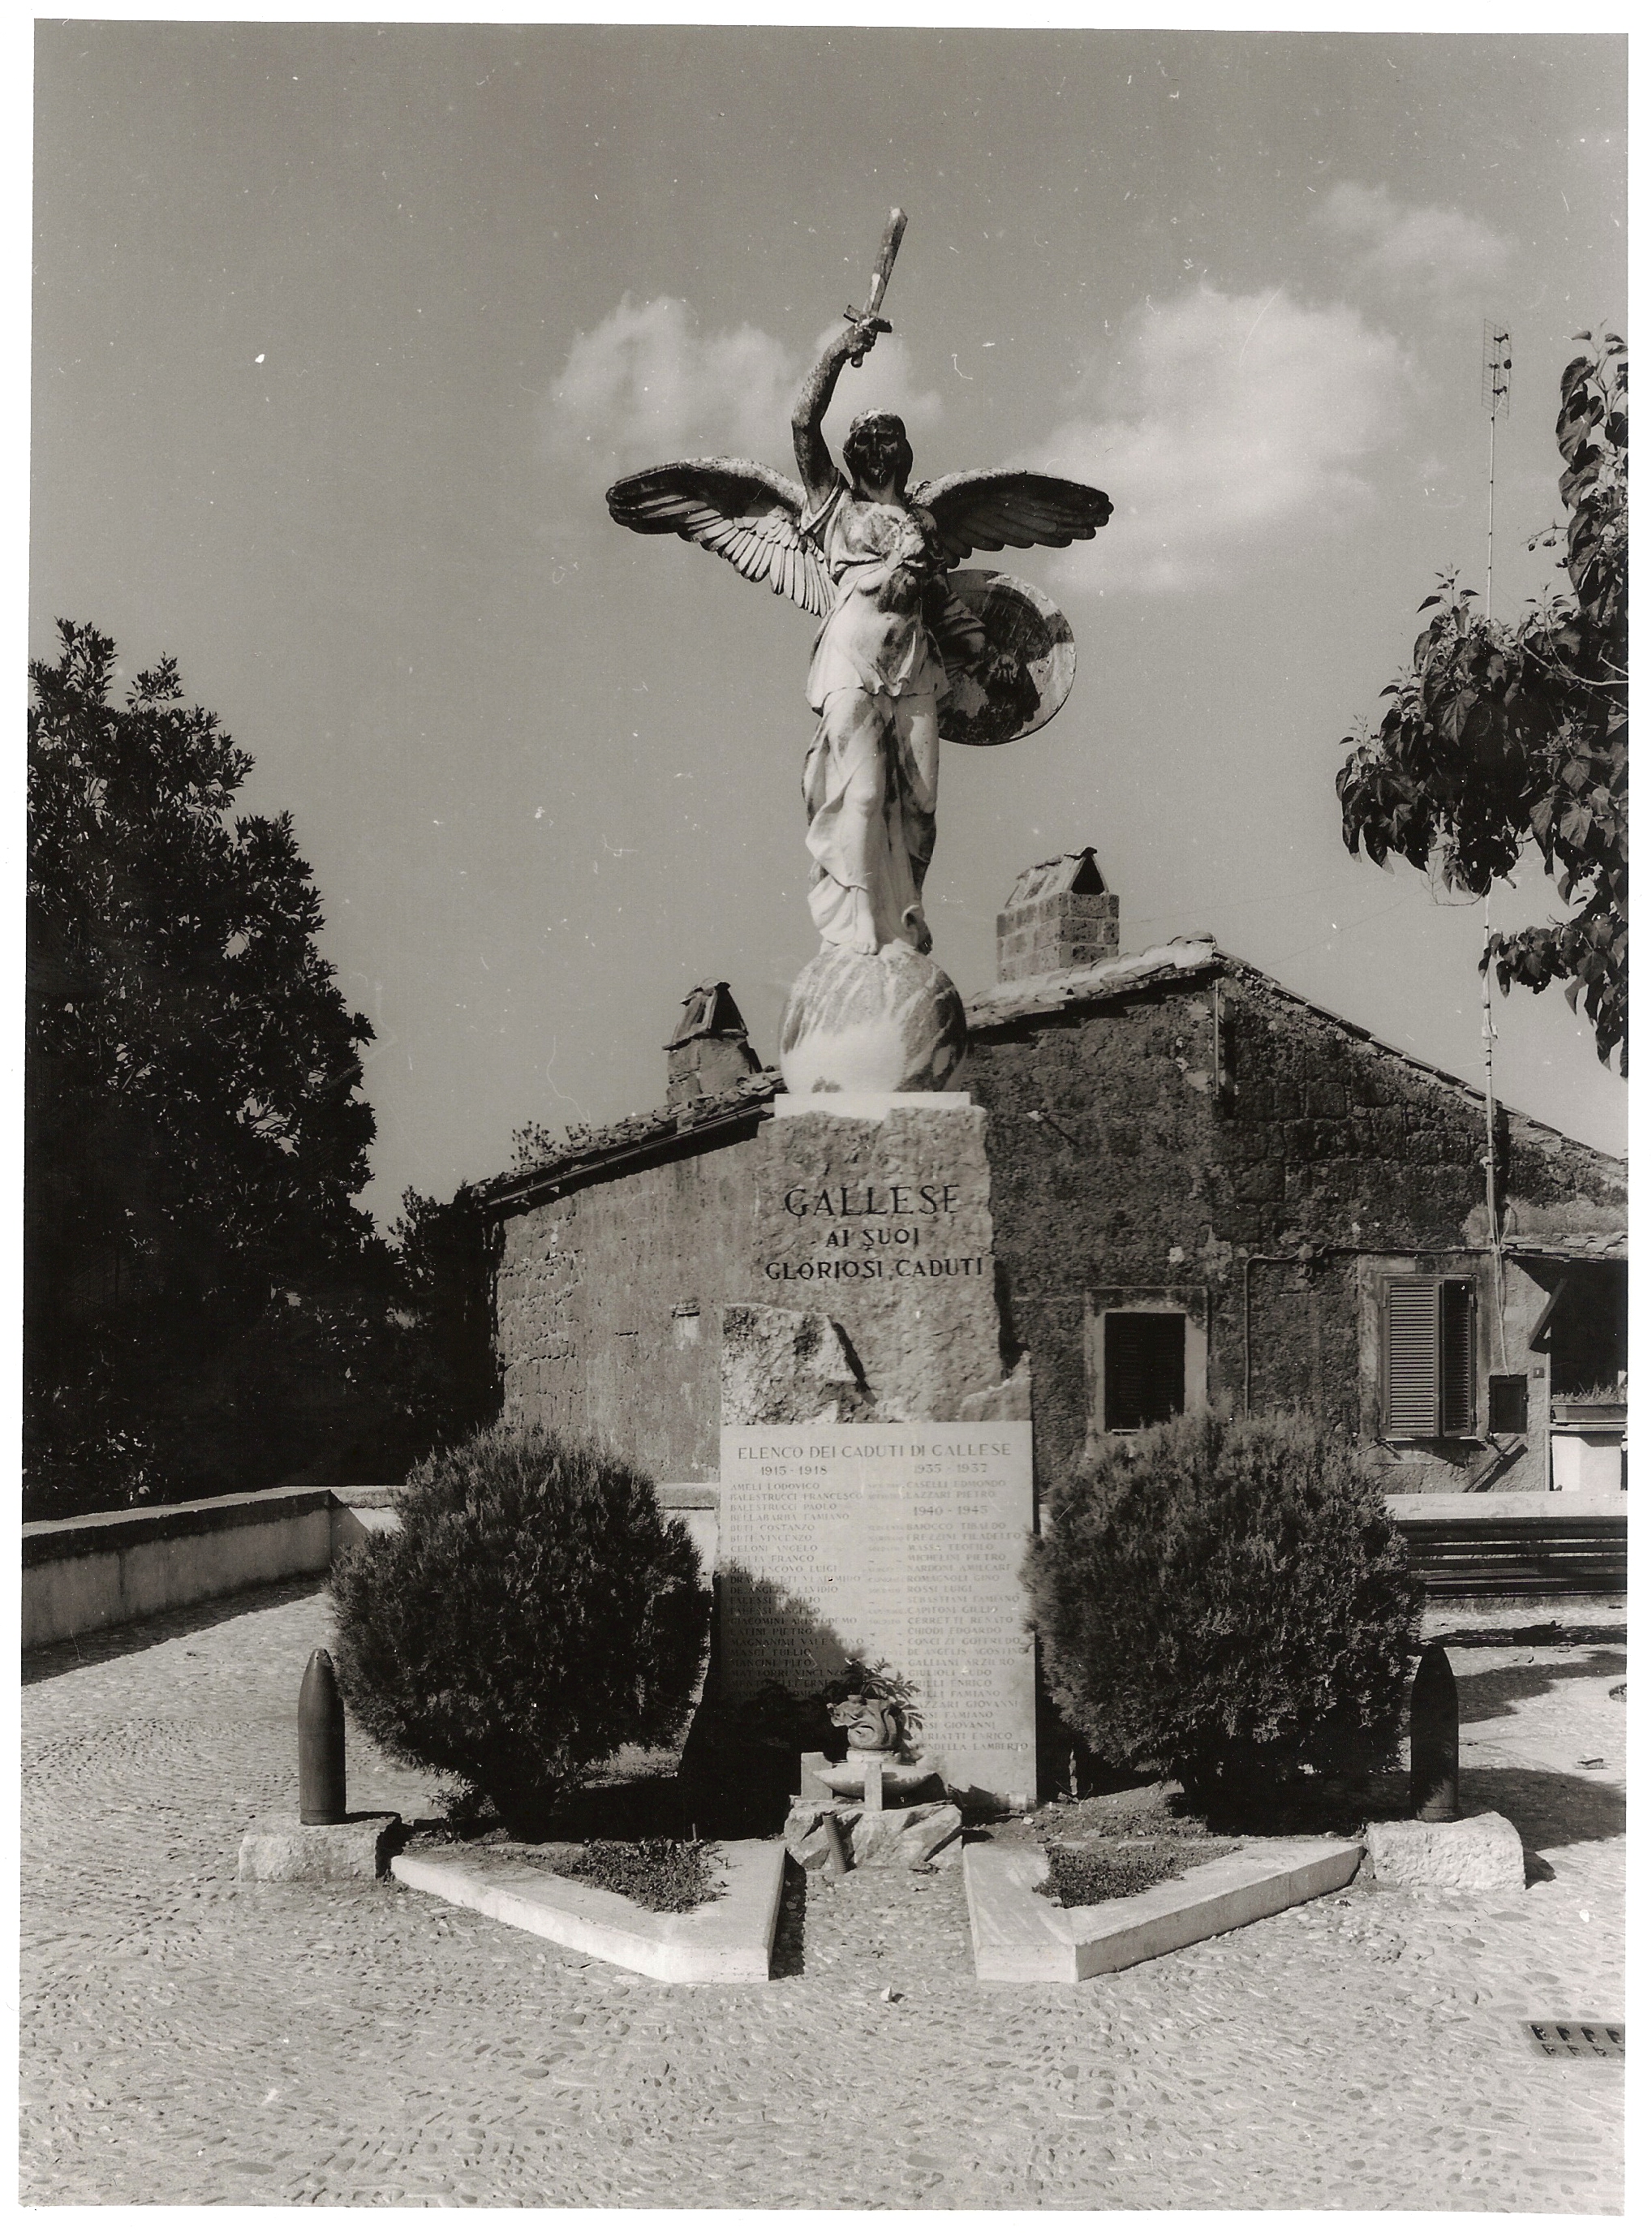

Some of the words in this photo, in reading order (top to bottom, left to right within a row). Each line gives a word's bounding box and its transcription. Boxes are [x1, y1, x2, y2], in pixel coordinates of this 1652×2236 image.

[785, 1185, 961, 1218] GALLESE
[824, 1228, 850, 1248] AI
[862, 1228, 920, 1247] SUOI
[765, 1260, 883, 1281] GLORIOSI
[896, 1257, 983, 1278] CADUTI
[738, 1446, 804, 1460] ELENCO
[809, 1446, 836, 1459] DEI
[841, 1445, 904, 1459] CADUTI
[910, 1444, 926, 1457] DI
[931, 1443, 1012, 1457] GALLESE
[760, 1465, 787, 1476] 1915
[798, 1465, 828, 1476] 1918
[914, 1464, 942, 1474] 1935
[731, 1483, 762, 1491] AMELI
[768, 1482, 820, 1490] LODOVICO
[953, 1479, 1007, 1487] EDMONDO
[730, 1493, 798, 1502] BALESTRUCCI
[803, 1492, 863, 1500] FRANCESCO
[906, 1491, 951, 1499] LAZZARI
[956, 1490, 996, 1499] PIETRO
[730, 1503, 798, 1511] BALESTRUCCI
[803, 1503, 837, 1511] PAOLO
[914, 1506, 944, 1516] 1940
[957, 1505, 989, 1516] 1945
[730, 1514, 797, 1522] BELLABARBA
[803, 1513, 850, 1521] FAMIANO
[759, 1524, 815, 1532] COSTANZO
[730, 1545, 768, 1553] CELONI
[777, 1544, 818, 1552] ANGELO
[771, 1554, 815, 1563] FRANCO
[907, 1554, 961, 1562] MICHELINI
[966, 1553, 1006, 1561] PIETRO
[809, 1564, 838, 1572] LUIGI
[959, 1563, 1012, 1572] AMILCARE
[973, 1574, 1000, 1582] GINO
[944, 1585, 972, 1593] LUIGI
[907, 1596, 968, 1604] SEBASTIANI
[972, 1595, 1021, 1603] FAMIANO
[906, 1617, 963, 1625] CERRETTI
[970, 1616, 1013, 1624] RENATO
[772, 1628, 813, 1636] PIETRO
[949, 1626, 1002, 1634] EDOARDO
[907, 1648, 919, 1656] DE
[924, 1648, 966, 1656] ANGELIS
[907, 1658, 959, 1666] GALLIANI
[950, 1679, 992, 1688] ENRICO
[950, 1689, 1000, 1697] FAMIANO
[917, 1701, 960, 1709] AZZARI
[965, 1700, 1018, 1708] GIOVANNI
[944, 1710, 993, 1718] FAMIANO
[944, 1721, 996, 1729] GIOVANNI
[972, 1731, 1013, 1740] ENRICO
[973, 1742, 1029, 1751] LAMBERTO
